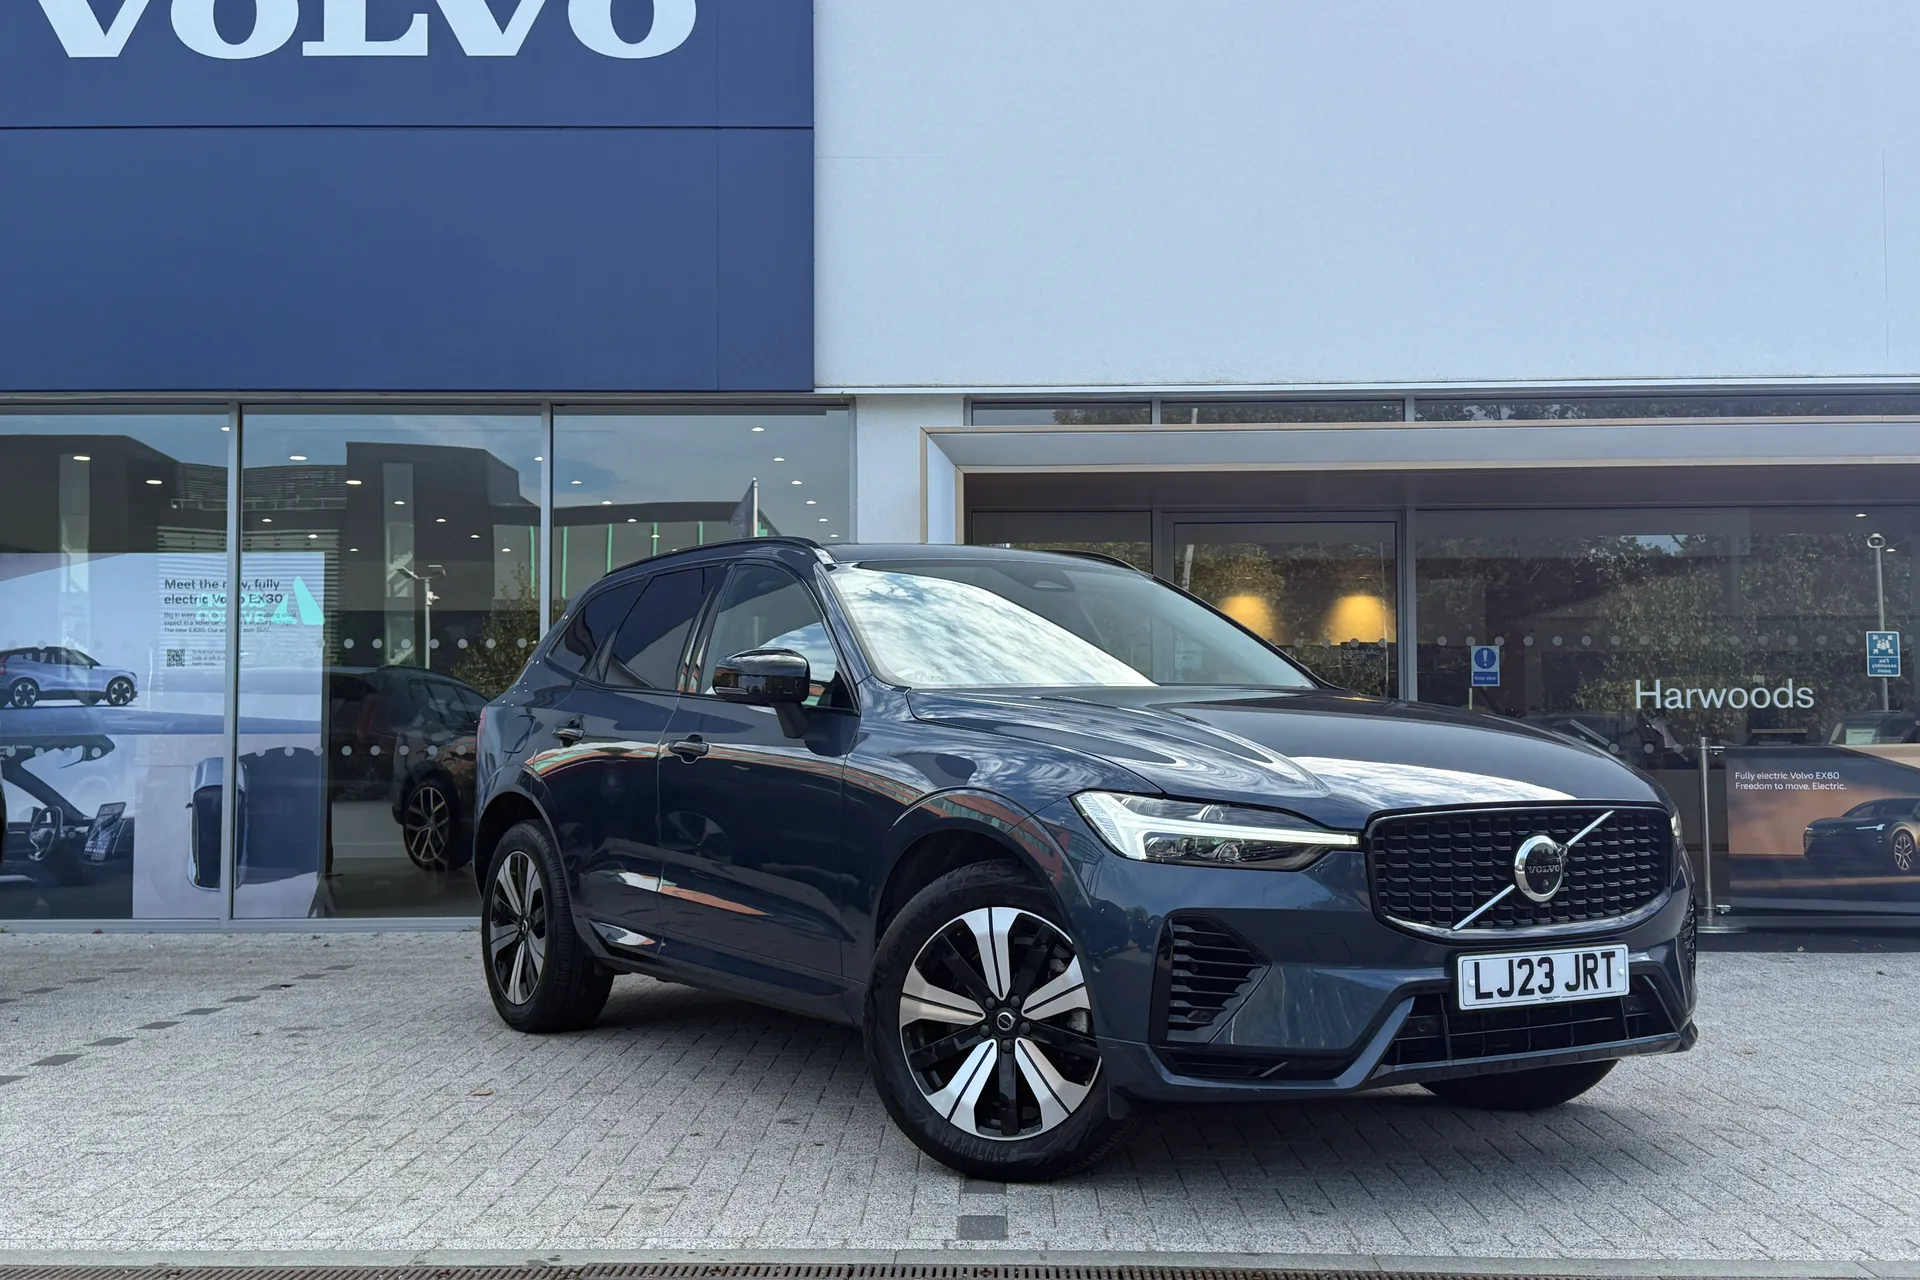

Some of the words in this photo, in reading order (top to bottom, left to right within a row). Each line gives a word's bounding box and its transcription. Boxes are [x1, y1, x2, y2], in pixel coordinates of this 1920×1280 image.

[38, 0, 696, 59] VOLVO
[164, 579, 195, 589] Meet
[200, 579, 219, 589] the
[255, 579, 280, 591] fully
[164, 594, 209, 604] electric
[249, 594, 283, 604] EX30
[1635, 678, 1815, 709] Harwoods
[1735, 772, 1755, 781] Fully
[1756, 772, 1788, 780] electric
[1789, 772, 1814, 780] Volvo
[1815, 772, 1840, 780] EX60
[1735, 782, 1773, 790] Freedom
[1812, 782, 1847, 790] Electric.
[1526, 865, 1560, 874] VOLVO
[1474, 956, 1555, 1000] LJ23
[1565, 951, 1616, 991] JRT
